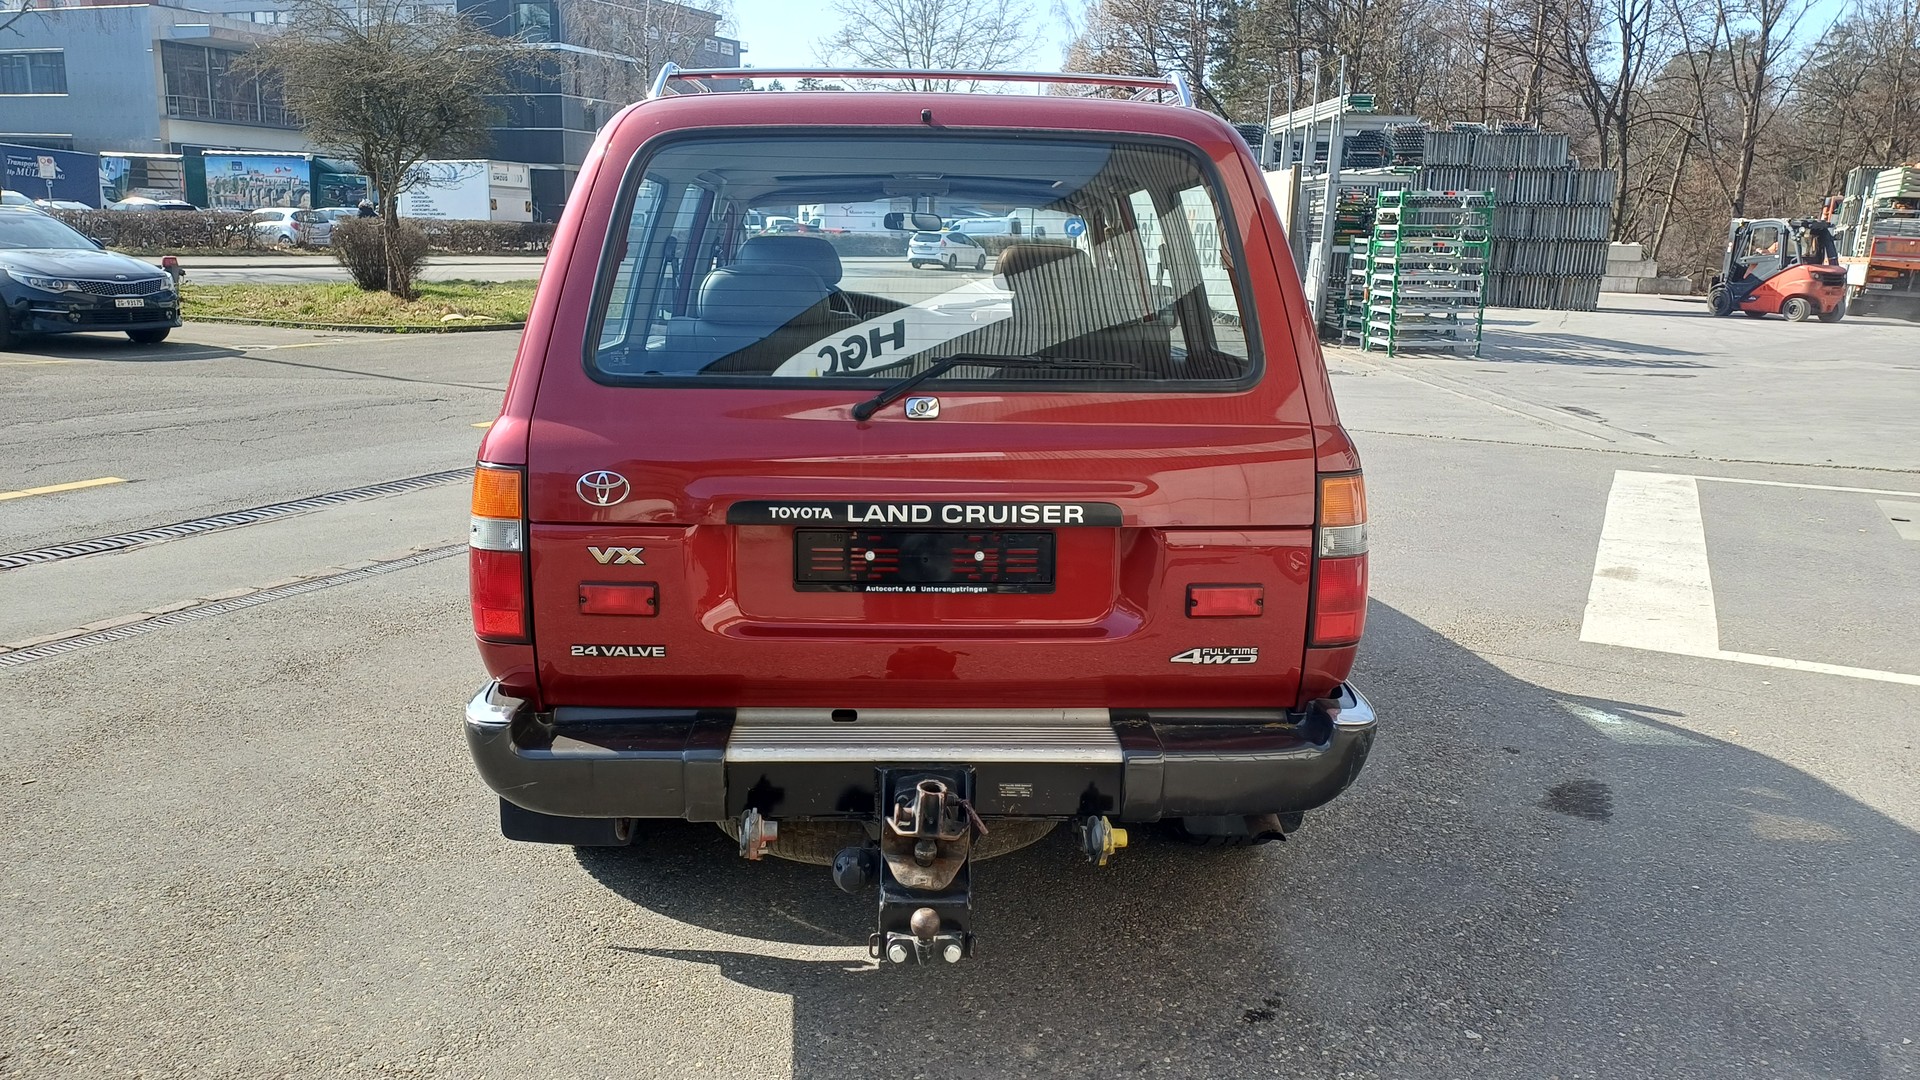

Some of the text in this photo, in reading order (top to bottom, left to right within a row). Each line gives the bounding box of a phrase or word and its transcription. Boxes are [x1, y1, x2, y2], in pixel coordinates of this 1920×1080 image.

[768, 504, 1084, 524] TOYOTA LAND CRUISER
[587, 546, 645, 565] VX
[920, 585, 988, 593] Unterengstringen
[571, 645, 665, 657] 24 VALVE
[1170, 648, 1258, 664] 4WD
[1231, 647, 1258, 655] TIME
